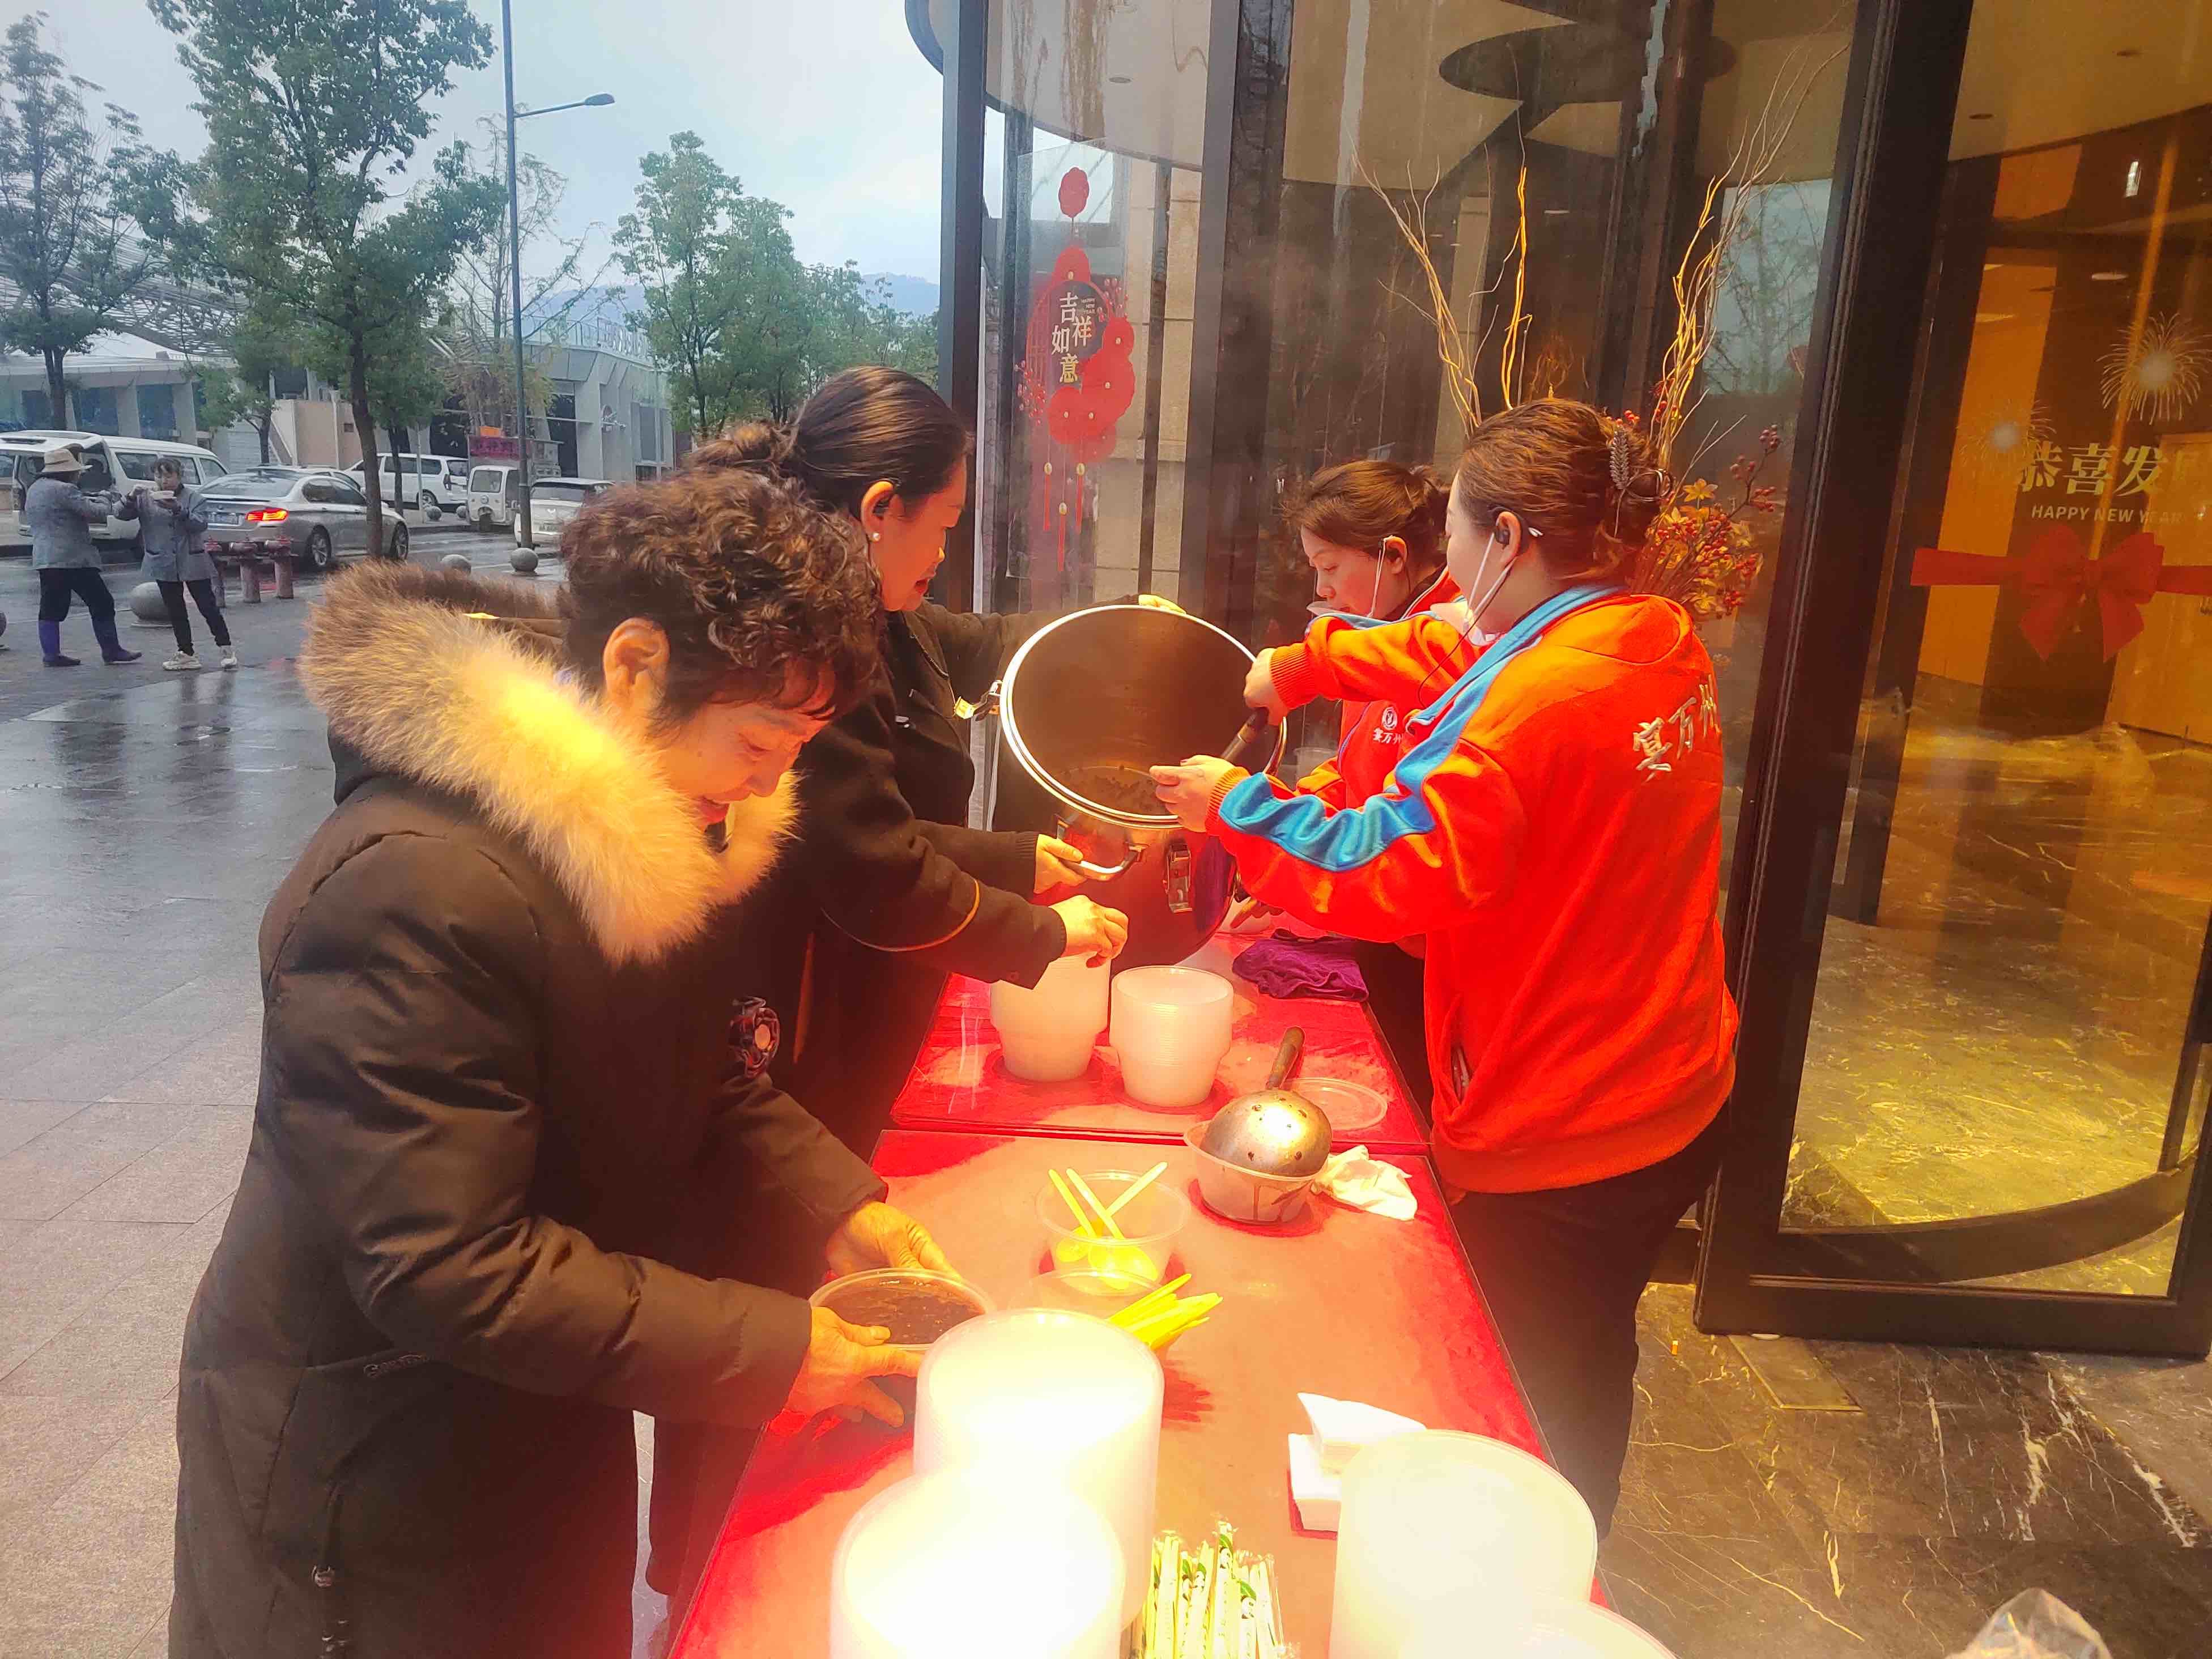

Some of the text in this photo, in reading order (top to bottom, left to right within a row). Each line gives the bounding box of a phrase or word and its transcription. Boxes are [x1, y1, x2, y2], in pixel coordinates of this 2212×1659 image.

[1051, 291, 1092, 383] 吉祥如意
[2031, 505, 2090, 521] HAPPY
[2094, 508, 2134, 523] NEW
